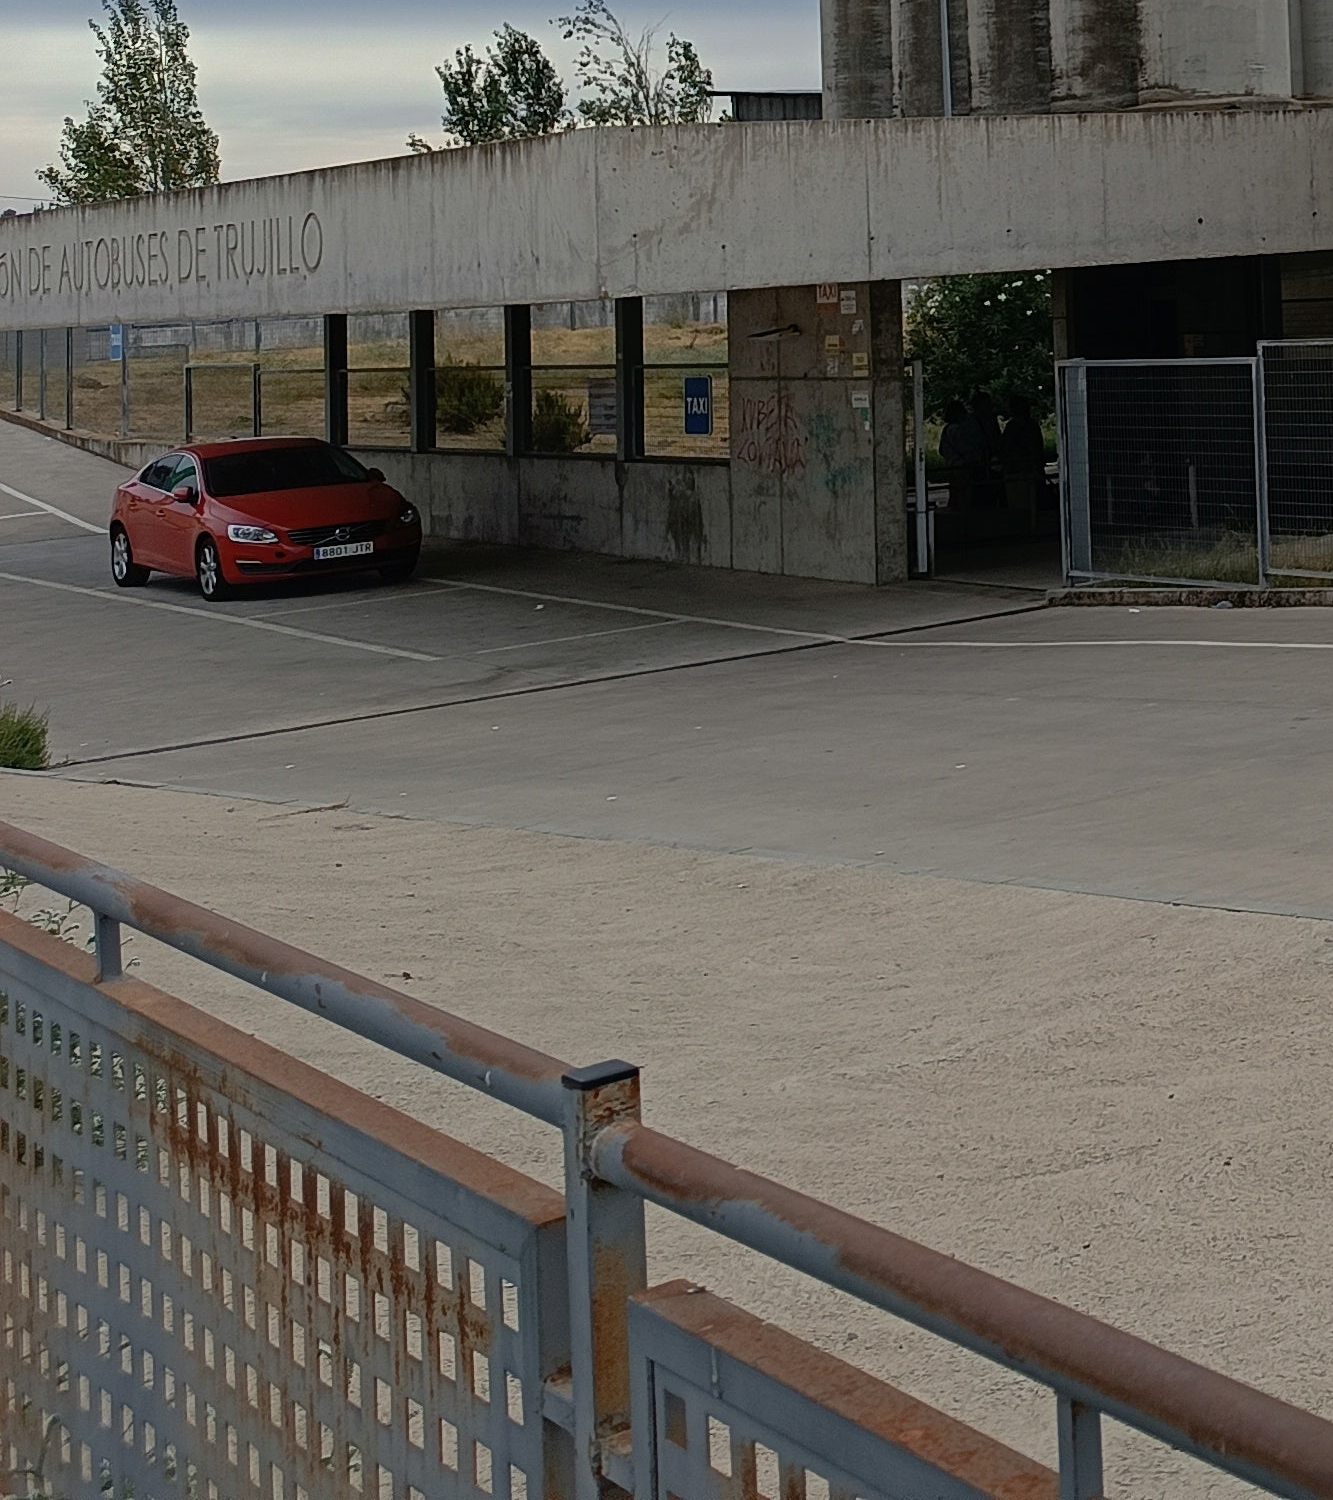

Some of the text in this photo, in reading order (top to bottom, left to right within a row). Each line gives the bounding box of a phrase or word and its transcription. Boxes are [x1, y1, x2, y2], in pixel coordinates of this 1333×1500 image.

[29, 246, 51, 296] DE
[58, 230, 169, 293] AUTOBUSES
[178, 227, 207, 284] DE
[214, 212, 323, 281] TRUJILLO
[818, 283, 837, 300] TAXI
[686, 397, 708, 415] TAXI
[322, 543, 371, 557] 8801 JTR
